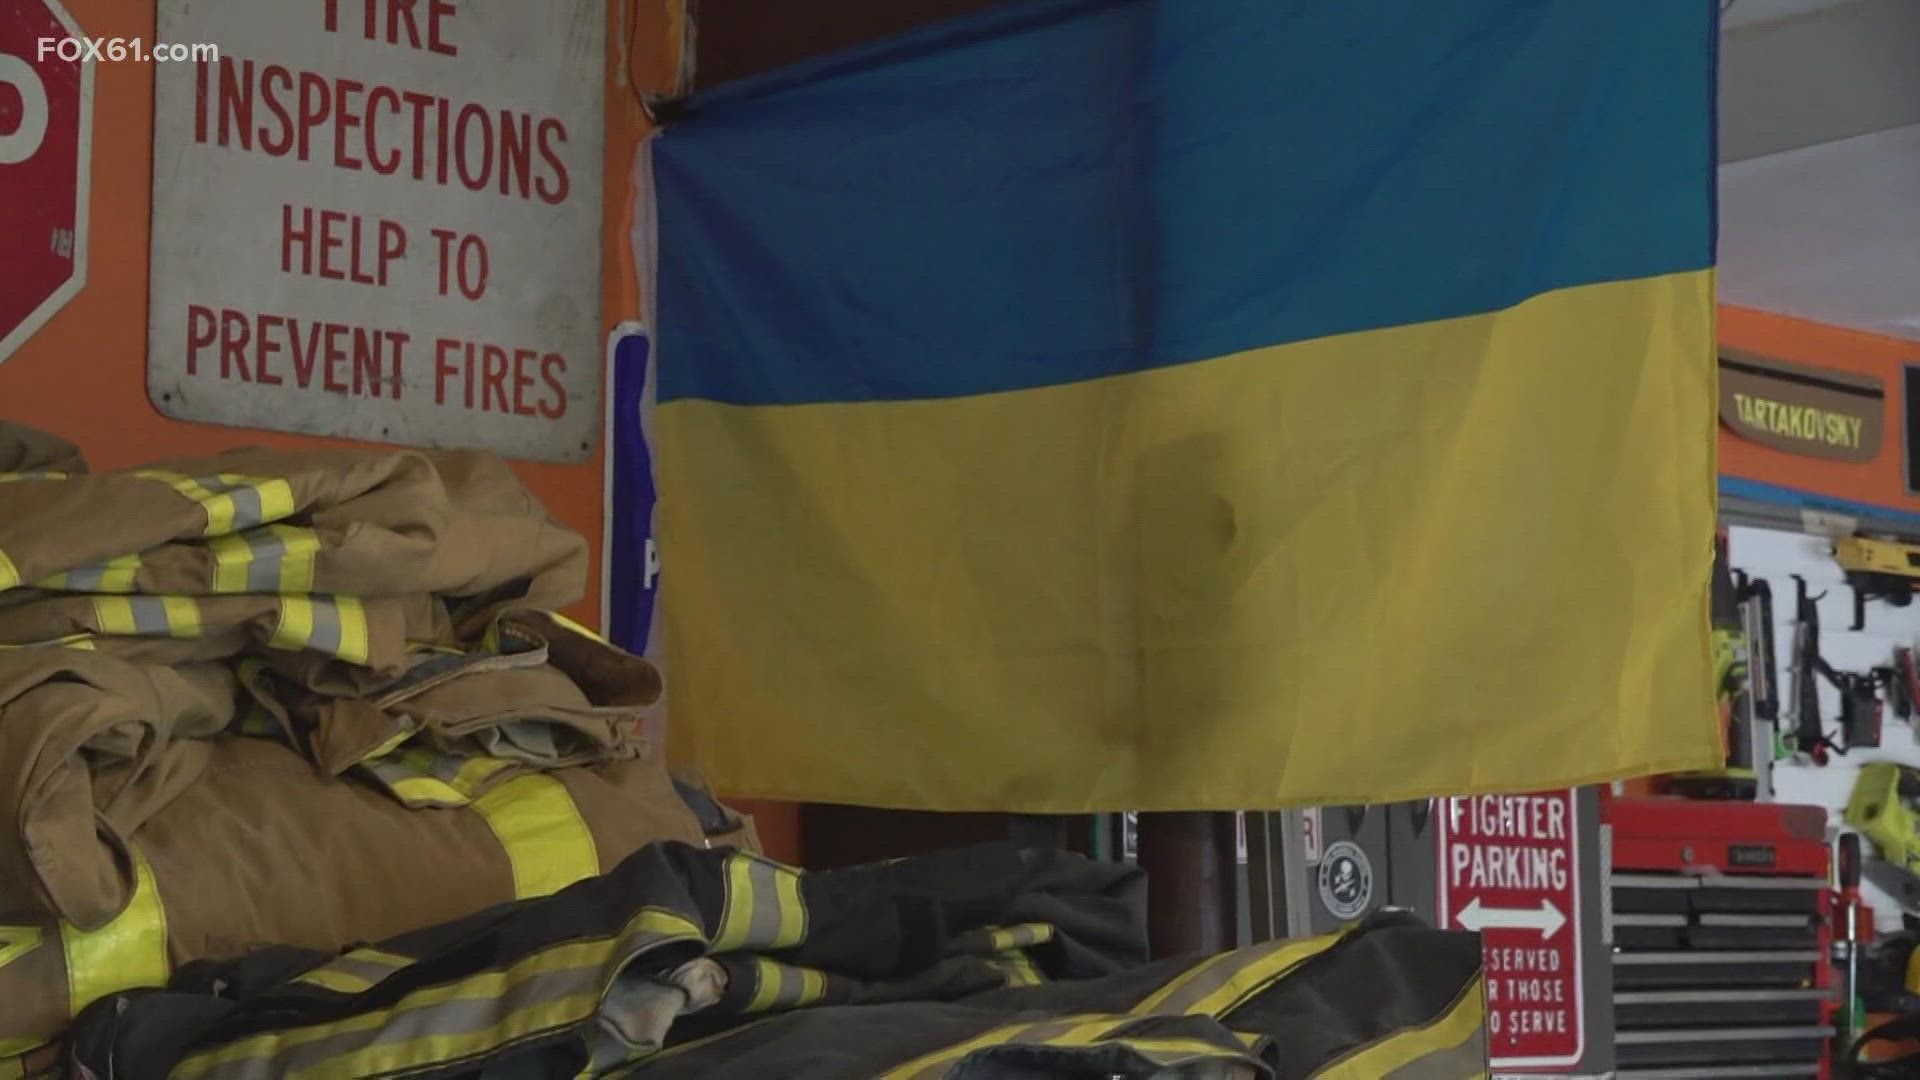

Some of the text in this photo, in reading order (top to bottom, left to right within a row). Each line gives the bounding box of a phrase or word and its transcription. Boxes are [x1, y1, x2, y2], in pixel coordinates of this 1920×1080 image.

[194, 52, 570, 205] INSPECTIONS
[281, 204, 488, 300] HELP TO
[186, 304, 567, 419] PREVENT FIRES
[1734, 393, 1862, 448] TARTAKOVSKY
[1451, 794, 1565, 839] FIGHTER
[1452, 843, 1567, 891] PARKING
[1507, 978, 1564, 1002] THOSE
[1510, 1010, 1566, 1033] SERVE
